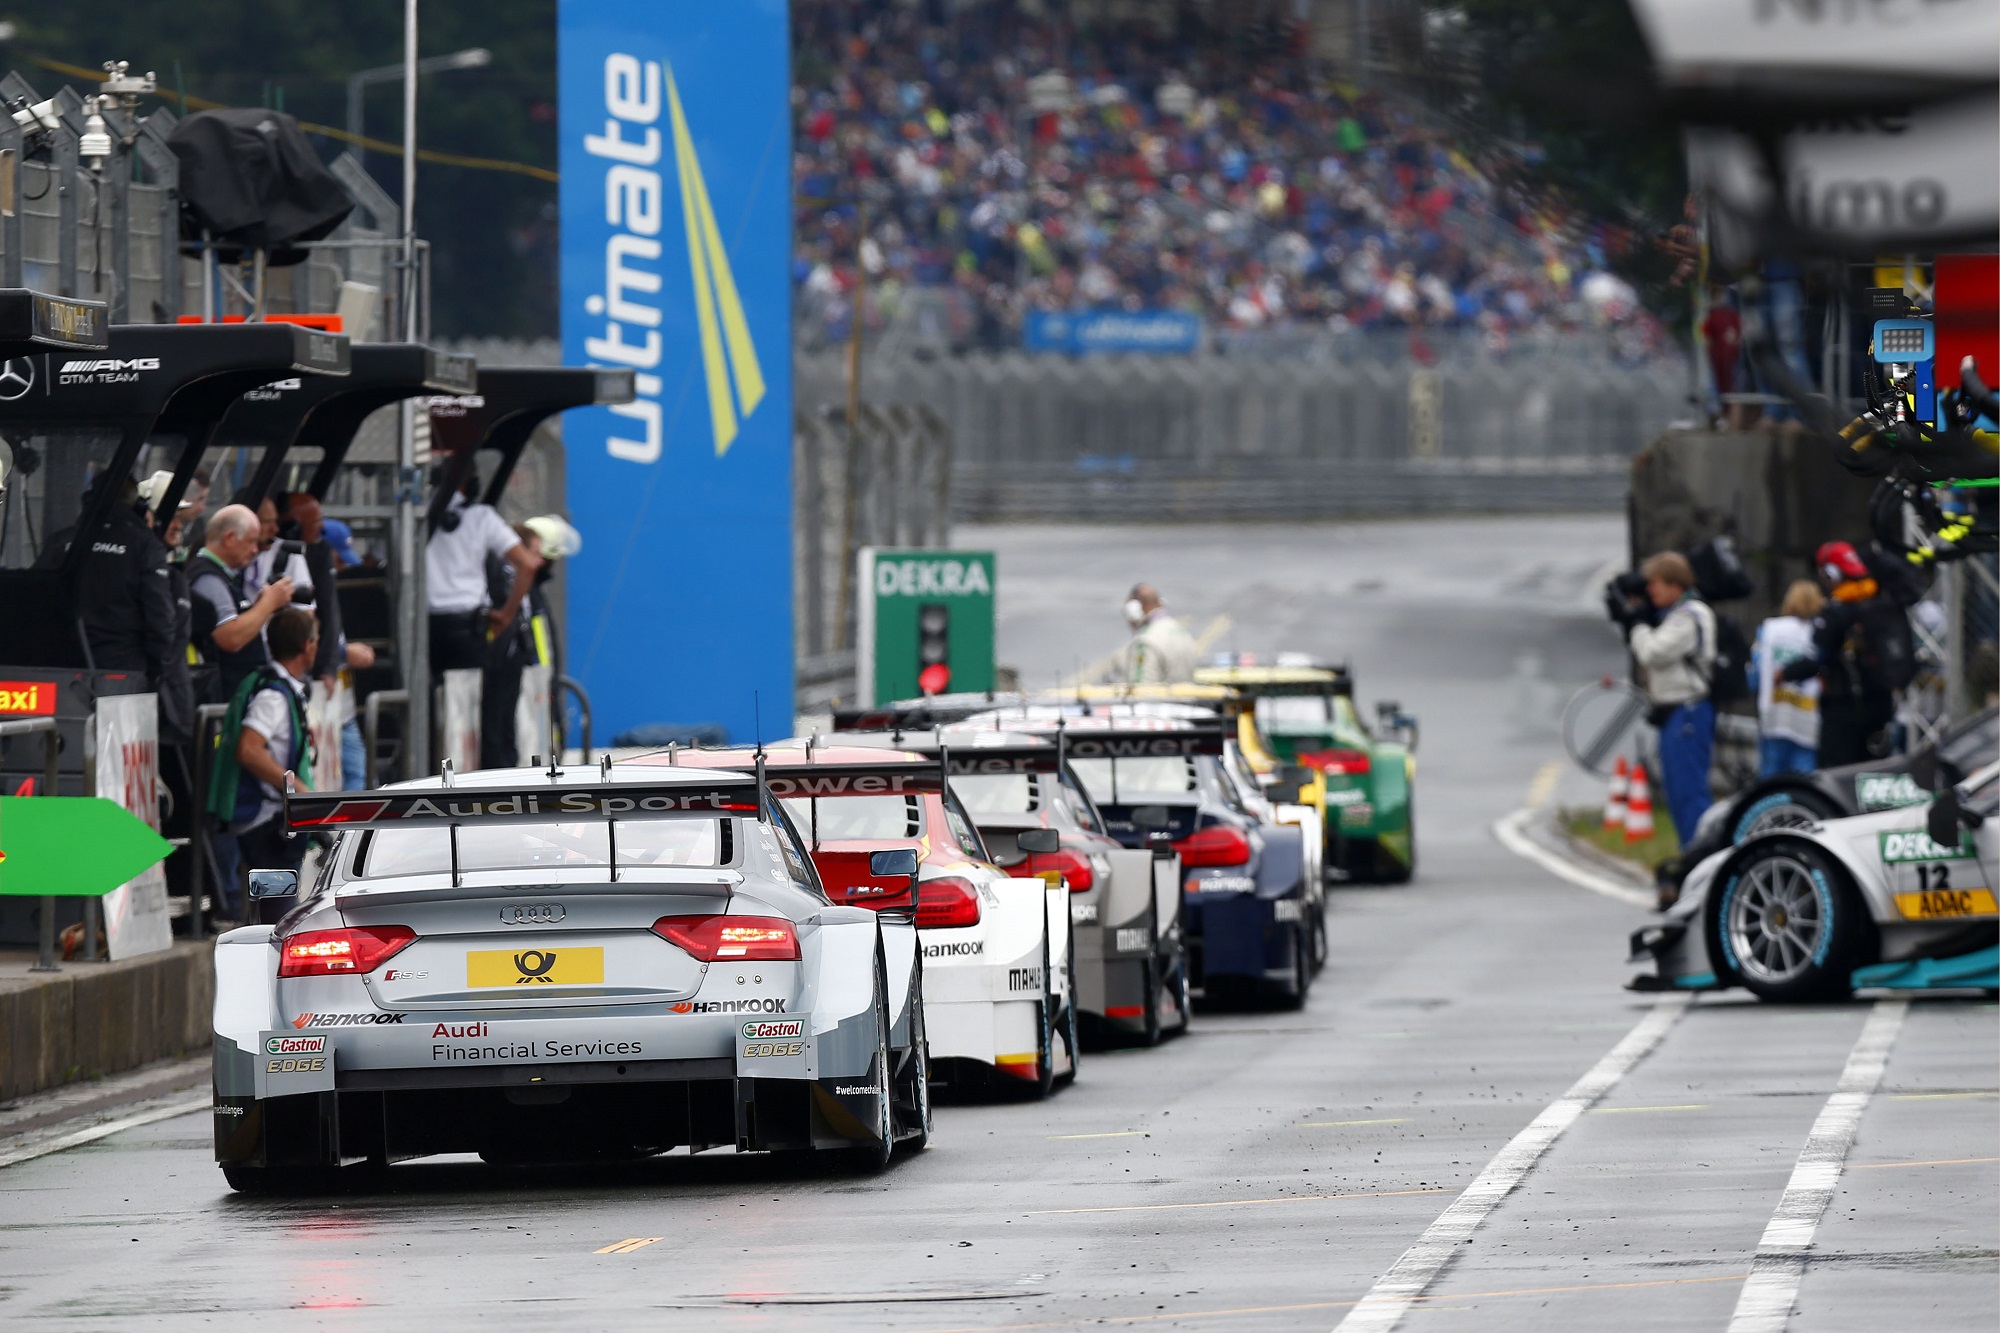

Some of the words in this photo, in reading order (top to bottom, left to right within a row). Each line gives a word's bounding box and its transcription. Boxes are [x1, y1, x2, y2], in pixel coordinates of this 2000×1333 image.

[92, 358, 160, 371] AMG
[60, 374, 94, 385] DTM
[97, 372, 140, 384] TEAM
[878, 559, 989, 596] DEKRA
[0, 685, 37, 711] axi
[948, 756, 1034, 775] wer
[766, 774, 914, 797] ower
[401, 795, 538, 818] Audi
[560, 791, 731, 816] Sport
[1917, 863, 1949, 890] 12
[1920, 889, 1973, 914] ADAC
[1009, 967, 1041, 991] MAHLE
[432, 1022, 488, 1039] Audi
[757, 1020, 800, 1037] Castrol
[281, 1036, 324, 1053] Castrol
[432, 1041, 538, 1061] Financial
[545, 1039, 642, 1058] Services
[743, 1041, 803, 1058] EDGE
[267, 1057, 326, 1074] EDGE
